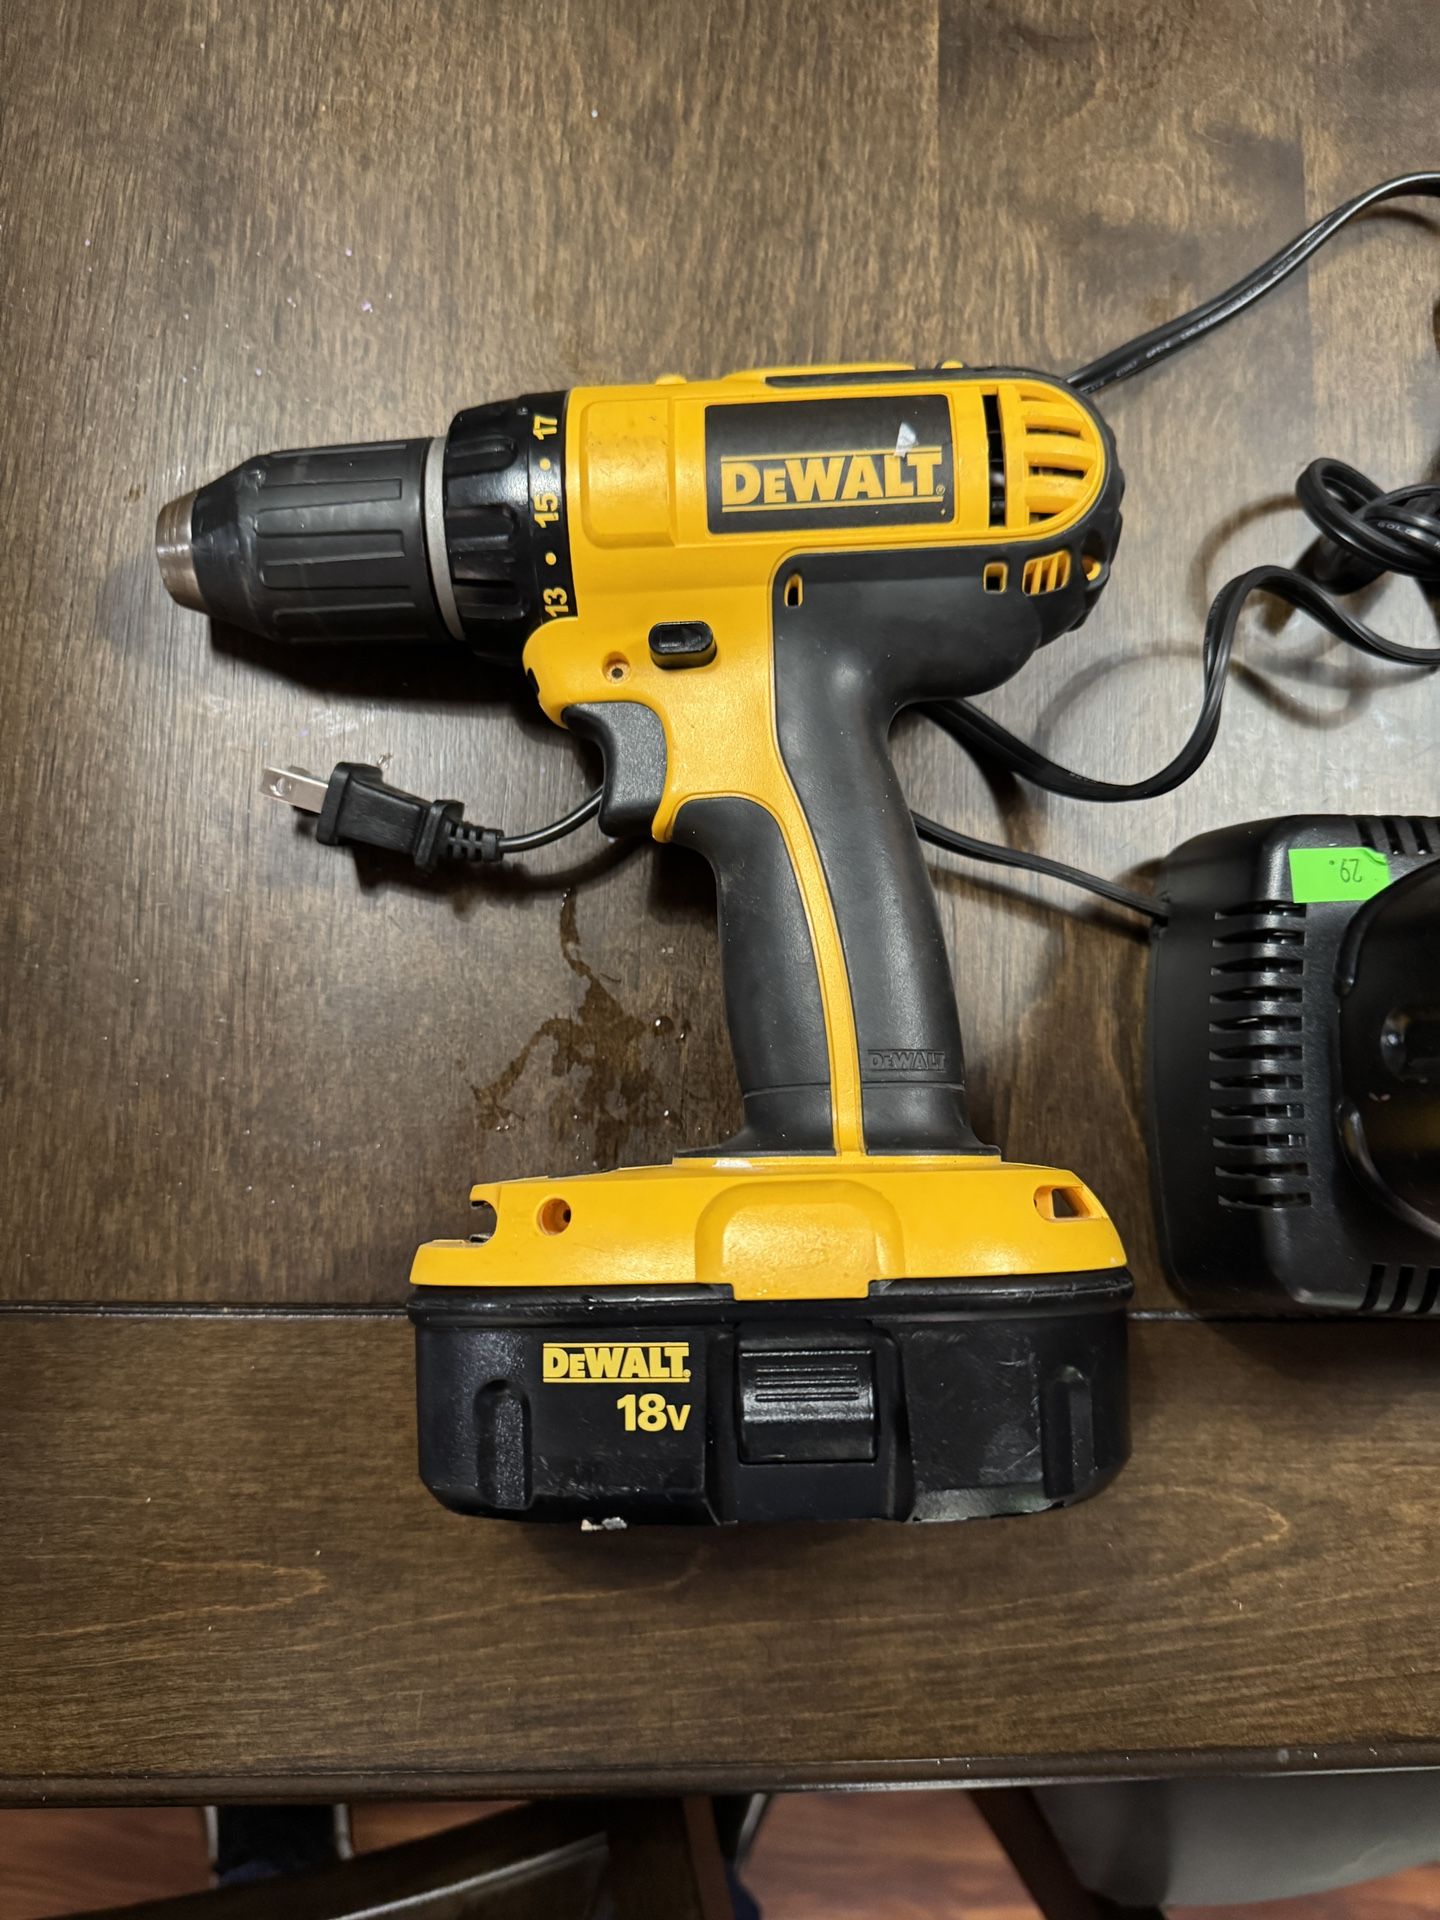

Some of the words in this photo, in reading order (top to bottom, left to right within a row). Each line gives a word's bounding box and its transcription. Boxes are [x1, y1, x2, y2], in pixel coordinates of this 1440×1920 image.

[532, 414, 557, 440] 17
[533, 492, 559, 529] 15
[542, 587, 569, 618] 13
